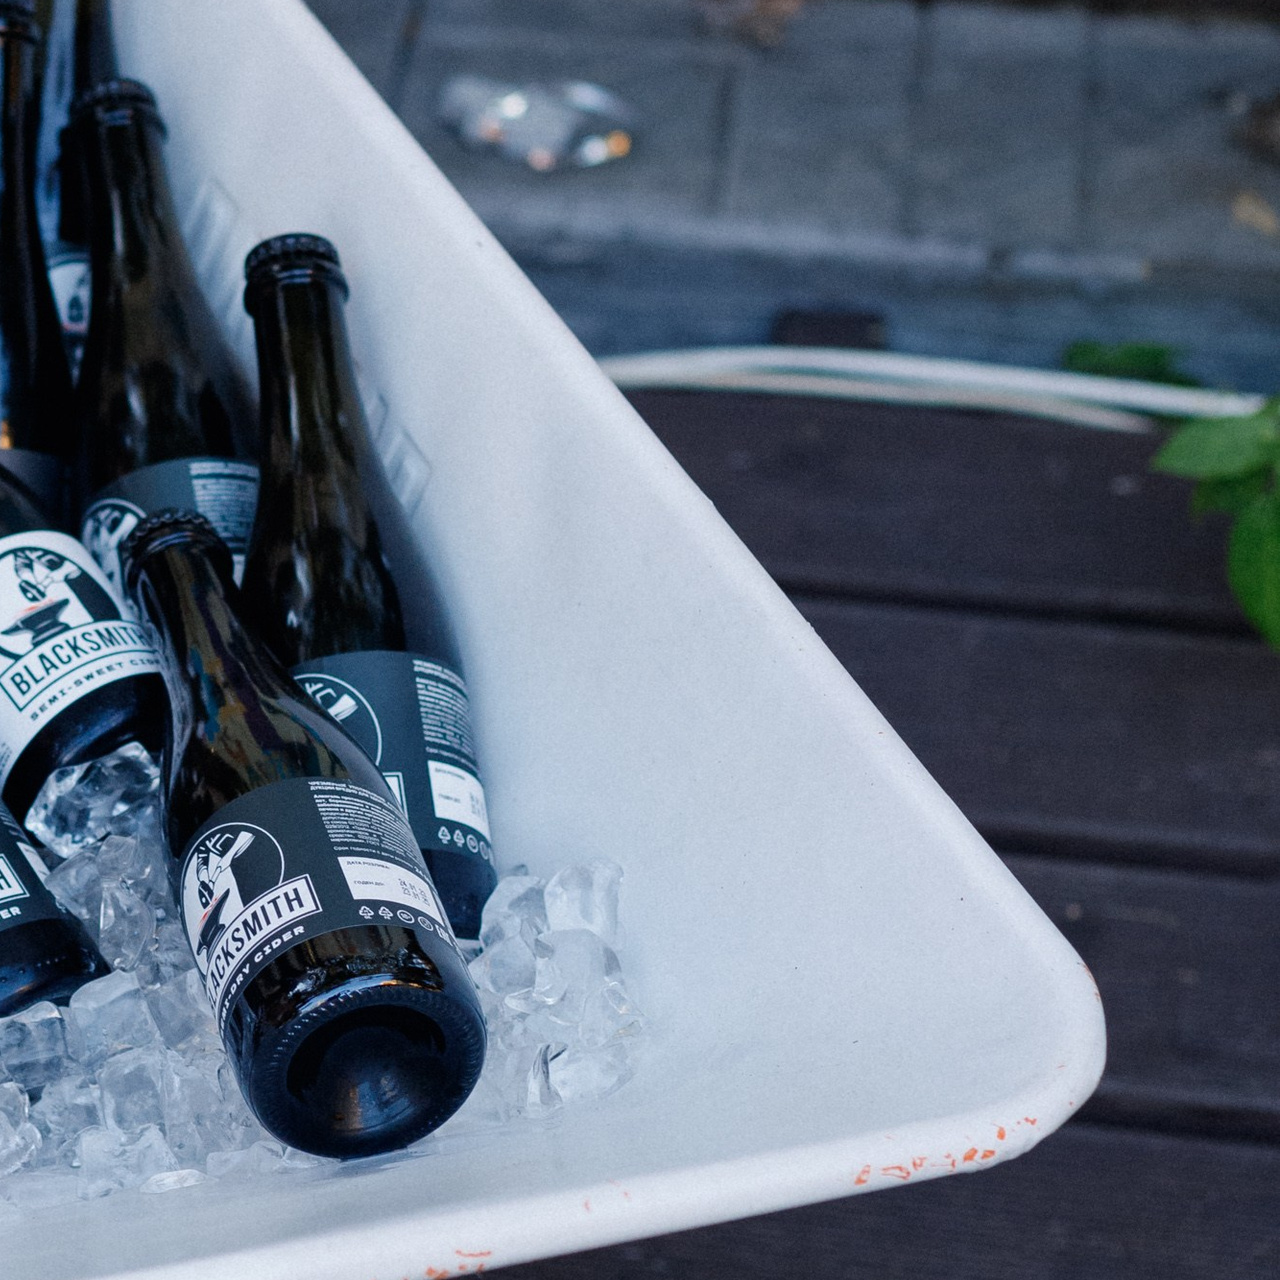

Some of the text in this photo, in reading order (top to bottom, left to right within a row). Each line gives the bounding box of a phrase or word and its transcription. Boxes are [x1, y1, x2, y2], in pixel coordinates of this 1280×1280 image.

[30, 662, 124, 722] SEMI-SWEET
[208, 887, 305, 1010] LACKSMITH
[253, 925, 306, 963] CIDER
